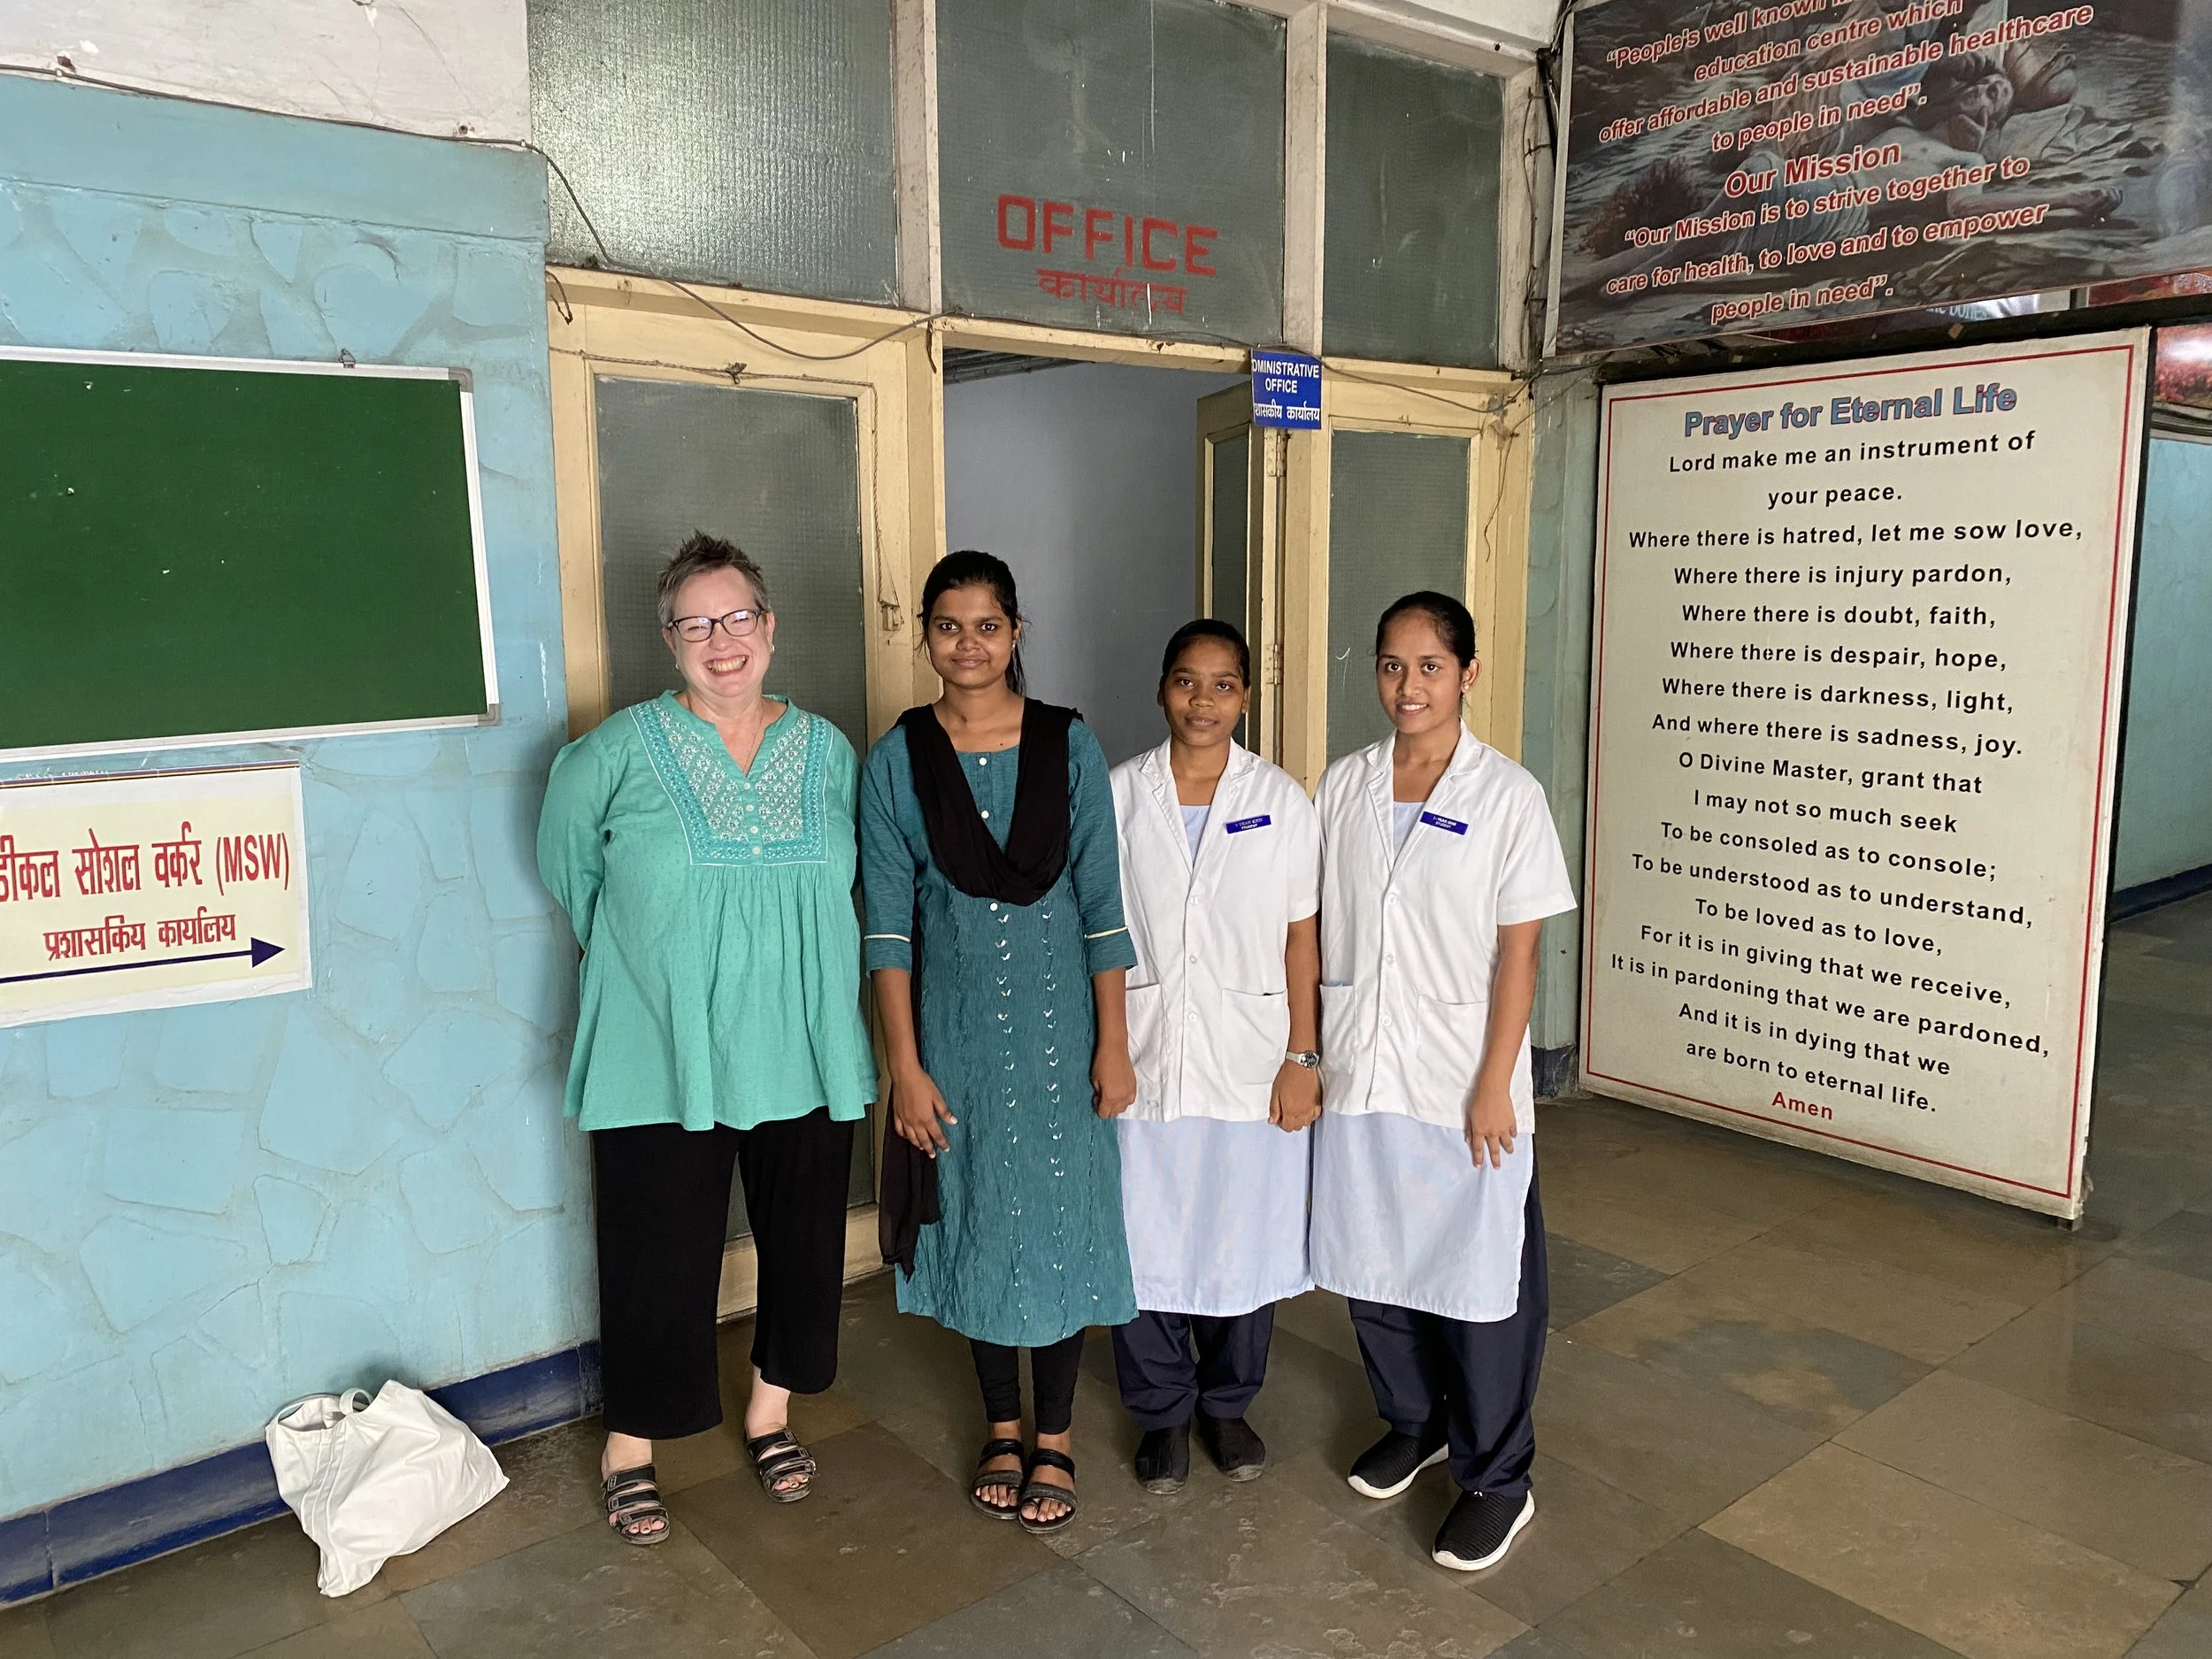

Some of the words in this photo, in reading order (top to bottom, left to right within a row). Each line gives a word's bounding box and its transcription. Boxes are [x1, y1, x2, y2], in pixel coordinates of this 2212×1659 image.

[1694, 38, 1801, 81] education
[1806, 18, 1881, 51] centre
[1887, 0, 1963, 30] which
[1704, 12, 1747, 42] well
[1752, 0, 1825, 28] known
[1599, 118, 1644, 143] offer
[1648, 88, 1752, 130] affordable
[1755, 71, 1799, 104] and
[1803, 40, 1944, 90] sustainable
[1948, 5, 2094, 56] healthcare
[1712, 132, 1734, 152] to
[1738, 111, 1813, 150] people
[1818, 105, 1840, 127] in
[1725, 169, 1778, 198] Our
[1784, 143, 1901, 187] Mission
[1674, 210, 1755, 241] Mission
[1760, 204, 1781, 224] is
[1786, 197, 1809, 218] to
[1813, 187, 1881, 213] strive
[1886, 163, 1996, 201] together
[2001, 154, 2030, 178] to
[997, 194, 1218, 277] OFFICE
[1606, 273, 1647, 295] care
[1652, 267, 1681, 288] for
[1685, 252, 1755, 281] health,
[1759, 249, 1783, 269] to
[1787, 239, 1836, 265] love
[1839, 227, 1887, 257] and
[1892, 225, 1919, 248] to
[1924, 203, 2050, 242] empower
[1710, 292, 1784, 326] people
[1788, 288, 1810, 309] in
[1265, 378, 1298, 394] OFFICE
[1286, 401, 1320, 421] कार्यालय
[1685, 411, 1774, 440] Prayer
[1780, 403, 1824, 429] for
[1831, 388, 1942, 425] Eternal
[1953, 383, 2017, 415] Life
[1671, 454, 1715, 472] Lord
[1723, 450, 1777, 469] make
[1786, 450, 1816, 465] me
[1825, 449, 1850, 462] an
[1861, 434, 1999, 460] instrument
[2008, 430, 2036, 450] of
[1768, 490, 1818, 510] your
[1826, 487, 1901, 507] peace.
[1630, 532, 1689, 548] Where
[1697, 530, 1749, 546] there
[1758, 528, 1774, 544] is
[1784, 526, 1862, 545] hatred,
[1872, 525, 1901, 541] let
[1909, 526, 1944, 541] me
[1955, 525, 2006, 540] sow
[2016, 519, 2081, 540] love,
[1674, 568, 1737, 584] Where
[1745, 567, 1800, 583] there
[1809, 566, 1826, 583] is
[1836, 565, 1903, 588] injury
[1912, 564, 2010, 587] pardon,
[1683, 605, 1746, 621] Where
[1754, 605, 1809, 622] there
[1817, 605, 1835, 623] is
[1845, 606, 1919, 627] doubt,
[1930, 606, 1994, 628] faith,
[1671, 641, 1733, 659] Where
[1741, 644, 1795, 661] there
[1804, 645, 1822, 662] is
[1831, 646, 1924, 669] despair,
[1936, 649, 2005, 672] hope,
[1663, 678, 1724, 696] Where
[1732, 681, 1786, 699] there
[1795, 684, 1812, 701] is
[1821, 685, 1936, 710] darkness,
[1947, 690, 2012, 714] light,
[1652, 714, 1690, 731] And
[1698, 718, 1758, 735] where
[1766, 721, 1822, 740] there
[1831, 725, 1848, 742] is
[1857, 728, 1966, 754] sadness,
[1974, 733, 2021, 758] joy.
[1679, 752, 1693, 767] O
[1701, 754, 1764, 774] Divine
[1773, 759, 1852, 785] Master,
[1862, 772, 1924, 788] grant
[1933, 773, 1982, 794] that
[1695, 789, 1699, 805] I
[1707, 795, 1747, 814] may
[1755, 799, 1788, 815] not
[1796, 804, 1821, 818] so
[1830, 808, 1891, 826] much
[1901, 815, 1957, 833] seek
[72, 827, 142, 895] सोशल
[151, 821, 203, 888] वर्कर
[216, 832, 290, 896] (MSW)
[1661, 822, 1682, 839] To
[1690, 826, 1712, 842] be
[1720, 833, 1816, 856] consoled
[1825, 846, 1849, 860] as
[1858, 847, 1879, 864] to
[1889, 854, 1995, 881] console;
[1632, 854, 1653, 871] To
[1661, 857, 1682, 874] be
[1690, 865, 1809, 893] understood
[1817, 884, 1841, 897] as
[1850, 885, 1870, 902] to
[1880, 892, 2032, 928] understand,
[157, 906, 236, 948] कार्यालय
[1695, 898, 1717, 916] To
[1725, 902, 1748, 921] be
[1756, 908, 1814, 932] loved
[1822, 923, 1846, 937] as
[1855, 925, 1876, 941] to
[1886, 928, 1941, 956] love,
[1641, 926, 1672, 944] For
[1679, 932, 1691, 948] it
[1698, 935, 1713, 951] is
[1722, 939, 1738, 956] in
[1747, 946, 1811, 973] giving
[1820, 957, 1863, 979] that
[1871, 970, 1901, 986] we
[1911, 977, 2009, 1009] receive,
[1612, 954, 1623, 970] It
[1631, 957, 1644, 973] is
[1652, 962, 1667, 979] in
[1676, 970, 1778, 1004] pardoning
[1786, 988, 1828, 1010] that
[1836, 1002, 1864, 1018] we
[1874, 1010, 1909, 1026] are
[1919, 1018, 2047, 1057] pardoned,
[1679, 1003, 1717, 1025] And
[1725, 1012, 1738, 1029] it
[1745, 1017, 1761, 1034] is
[1770, 1022, 1786, 1040] in
[1795, 1028, 1855, 1058] dying
[1864, 1043, 1909, 1067] that
[1918, 1057, 1949, 1075] we
[1686, 1043, 1717, 1059] are
[1724, 1048, 1770, 1072] born
[1778, 1062, 1797, 1079] to
[1805, 1071, 1883, 1099] eternal
[1893, 1087, 1935, 1111] life.
[1772, 1092, 1832, 1119] Amen
